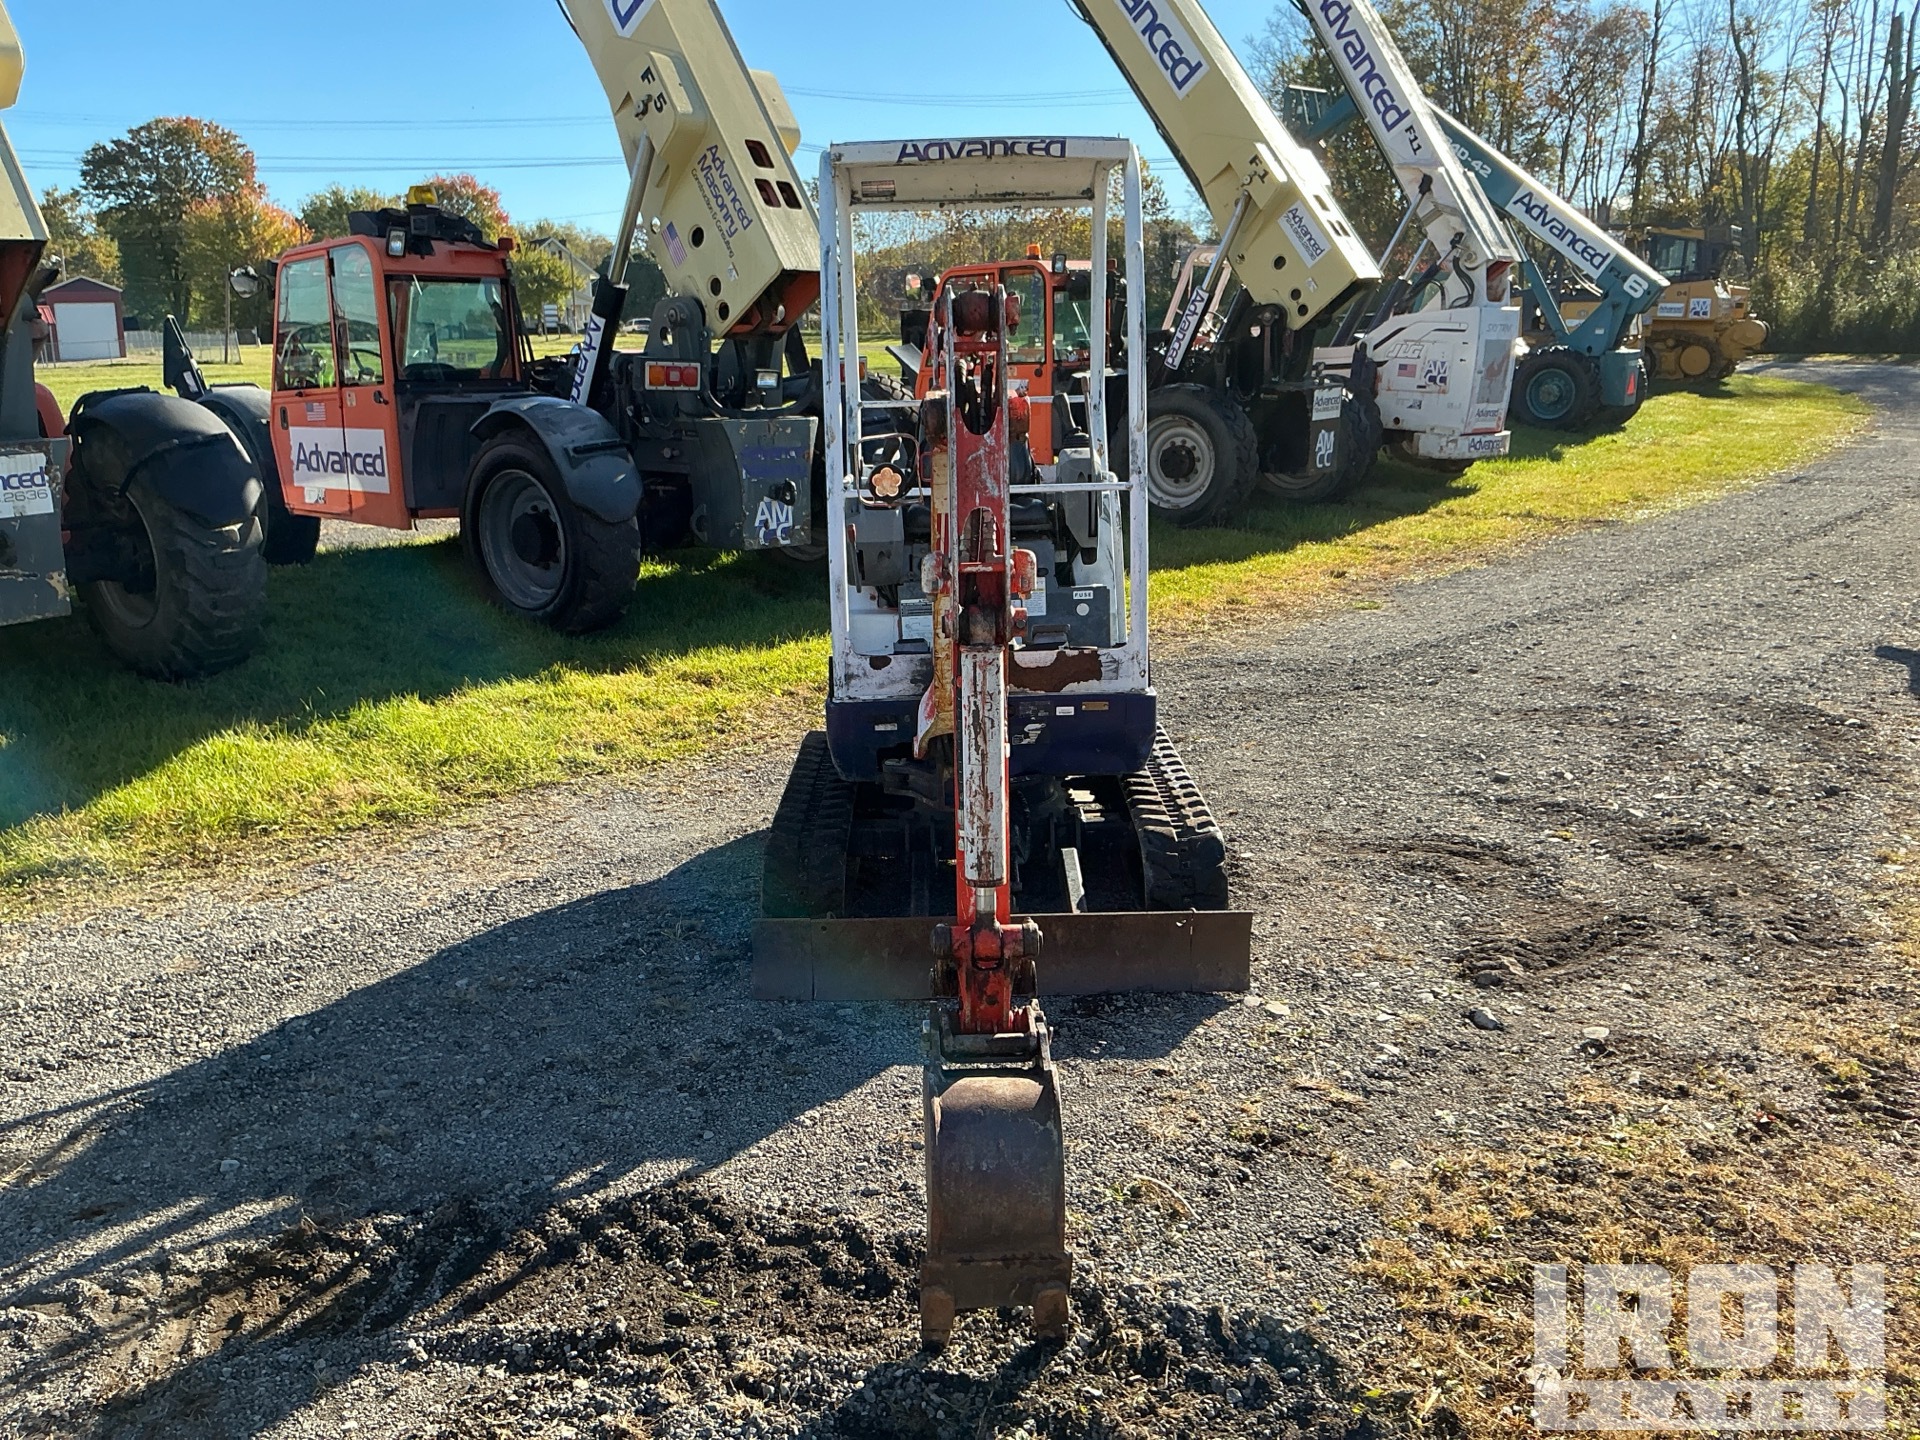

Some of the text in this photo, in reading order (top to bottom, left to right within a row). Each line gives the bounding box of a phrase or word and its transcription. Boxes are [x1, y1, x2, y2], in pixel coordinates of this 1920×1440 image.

[896, 137, 1067, 163] Advanced
[1405, 125, 1423, 156] F11
[697, 153, 739, 239] Masonry
[706, 144, 753, 231] Advanced
[691, 168, 714, 215] Construction
[715, 220, 735, 259] Consulting
[1288, 207, 1325, 257] Advanced
[1513, 191, 1611, 271] Advanced
[1623, 273, 1649, 298] 6
[1165, 291, 1205, 369] Advanced
[1386, 343, 1425, 359] JLG
[1425, 360, 1449, 374] AM
[1425, 372, 1448, 386] CC
[1314, 395, 1340, 407] Advanced
[1315, 430, 1335, 454] AM
[295, 442, 386, 477] Advanced
[1316, 449, 1333, 468] CC
[754, 500, 793, 529] AM
